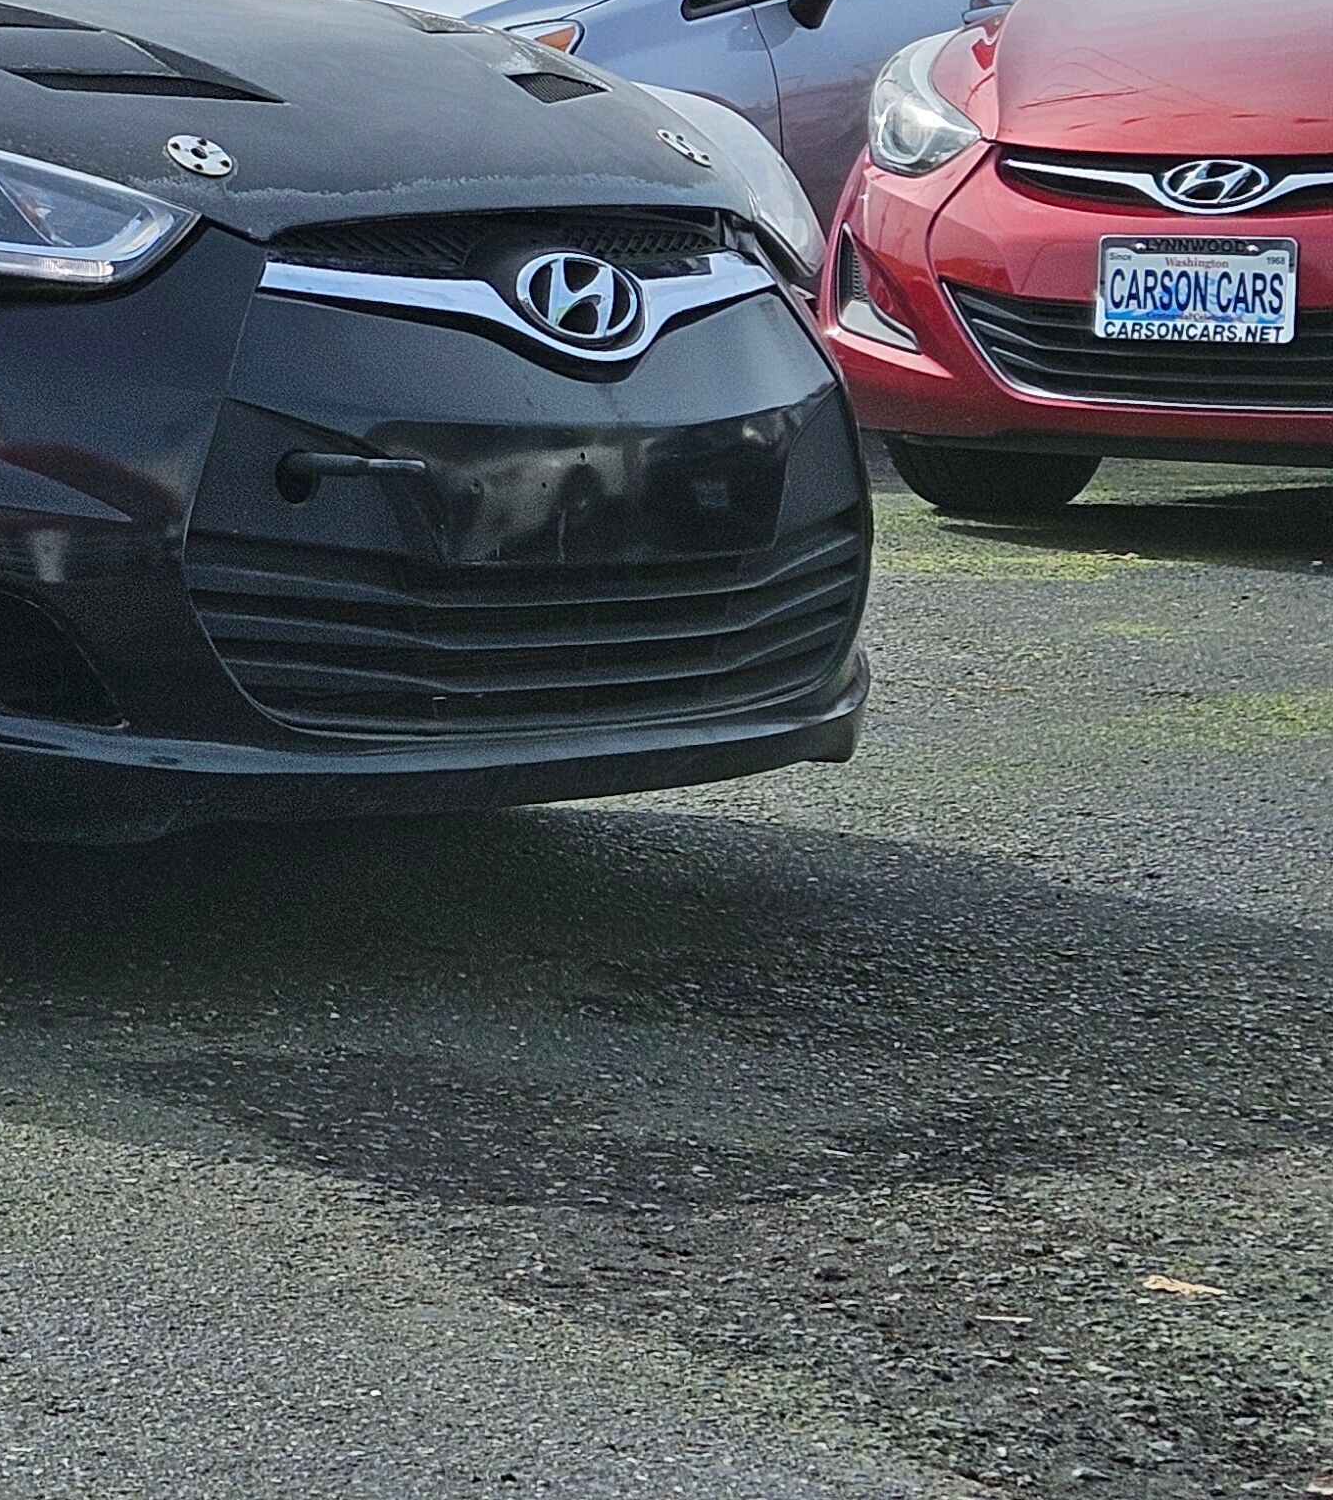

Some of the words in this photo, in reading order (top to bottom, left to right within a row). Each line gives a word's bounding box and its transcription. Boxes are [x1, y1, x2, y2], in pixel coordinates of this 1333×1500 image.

[1145, 238, 1248, 253] LYNNWOOD
[1109, 252, 1132, 262] Since
[1266, 256, 1286, 266] 1968
[1164, 256, 1230, 270] Washington
[1110, 268, 1209, 312] CARSON
[1216, 271, 1284, 315] CARS
[1103, 321, 1285, 343] CARSONCARS.NET
